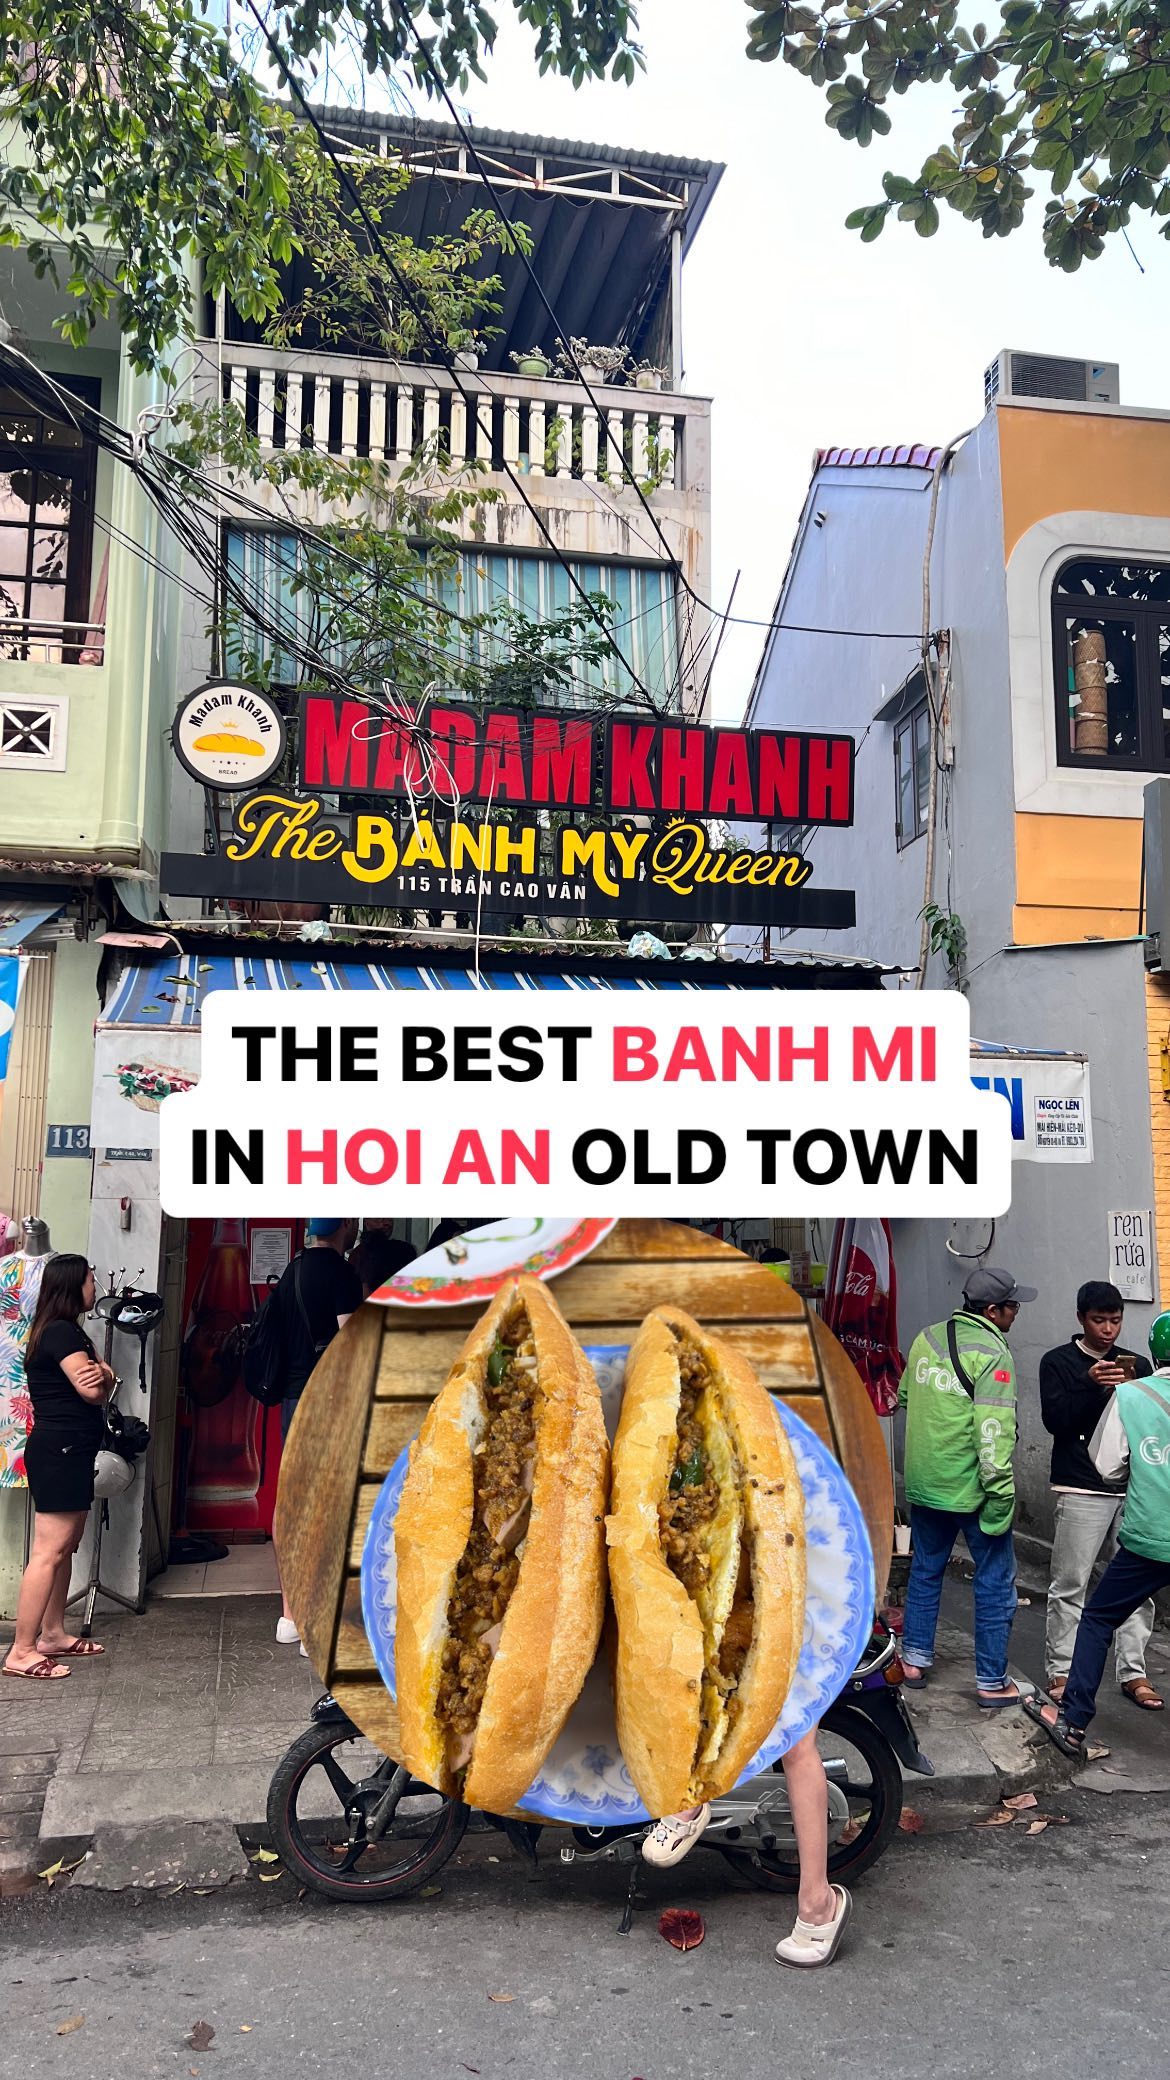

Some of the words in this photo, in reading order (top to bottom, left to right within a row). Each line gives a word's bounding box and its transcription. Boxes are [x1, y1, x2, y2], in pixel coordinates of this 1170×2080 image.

[189, 694, 233, 728] Madam
[237, 694, 273, 733] Khanh
[304, 698, 593, 805] MADAM
[610, 723, 850, 821] KHANH
[227, 794, 343, 861] The
[341, 809, 536, 883] BÁNH
[652, 824, 809, 895] Queen
[397, 876, 431, 892] 115
[499, 881, 539, 899] CAO
[546, 881, 586, 900] VÂN
[52, 1127, 89, 1149] 113
[1113, 1214, 1144, 1237] ren
